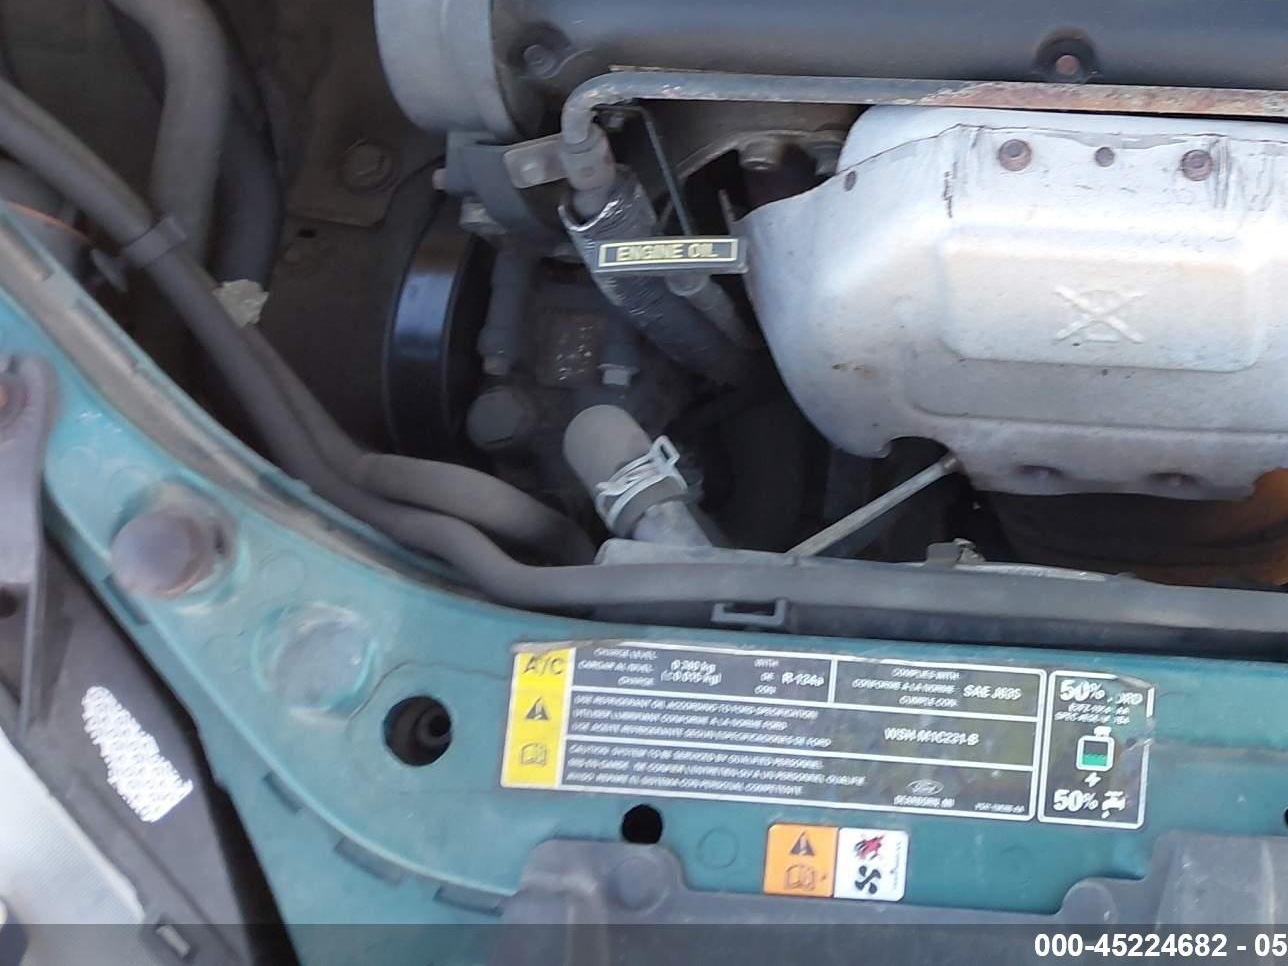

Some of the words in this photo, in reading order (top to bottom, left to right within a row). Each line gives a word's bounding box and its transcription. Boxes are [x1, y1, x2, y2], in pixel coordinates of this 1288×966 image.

[616, 243, 684, 261] ENGINE
[688, 243, 719, 258] OIL
[523, 656, 565, 676] A/C
[1060, 679, 1105, 702] 50%
[1053, 789, 1099, 812] 50%
